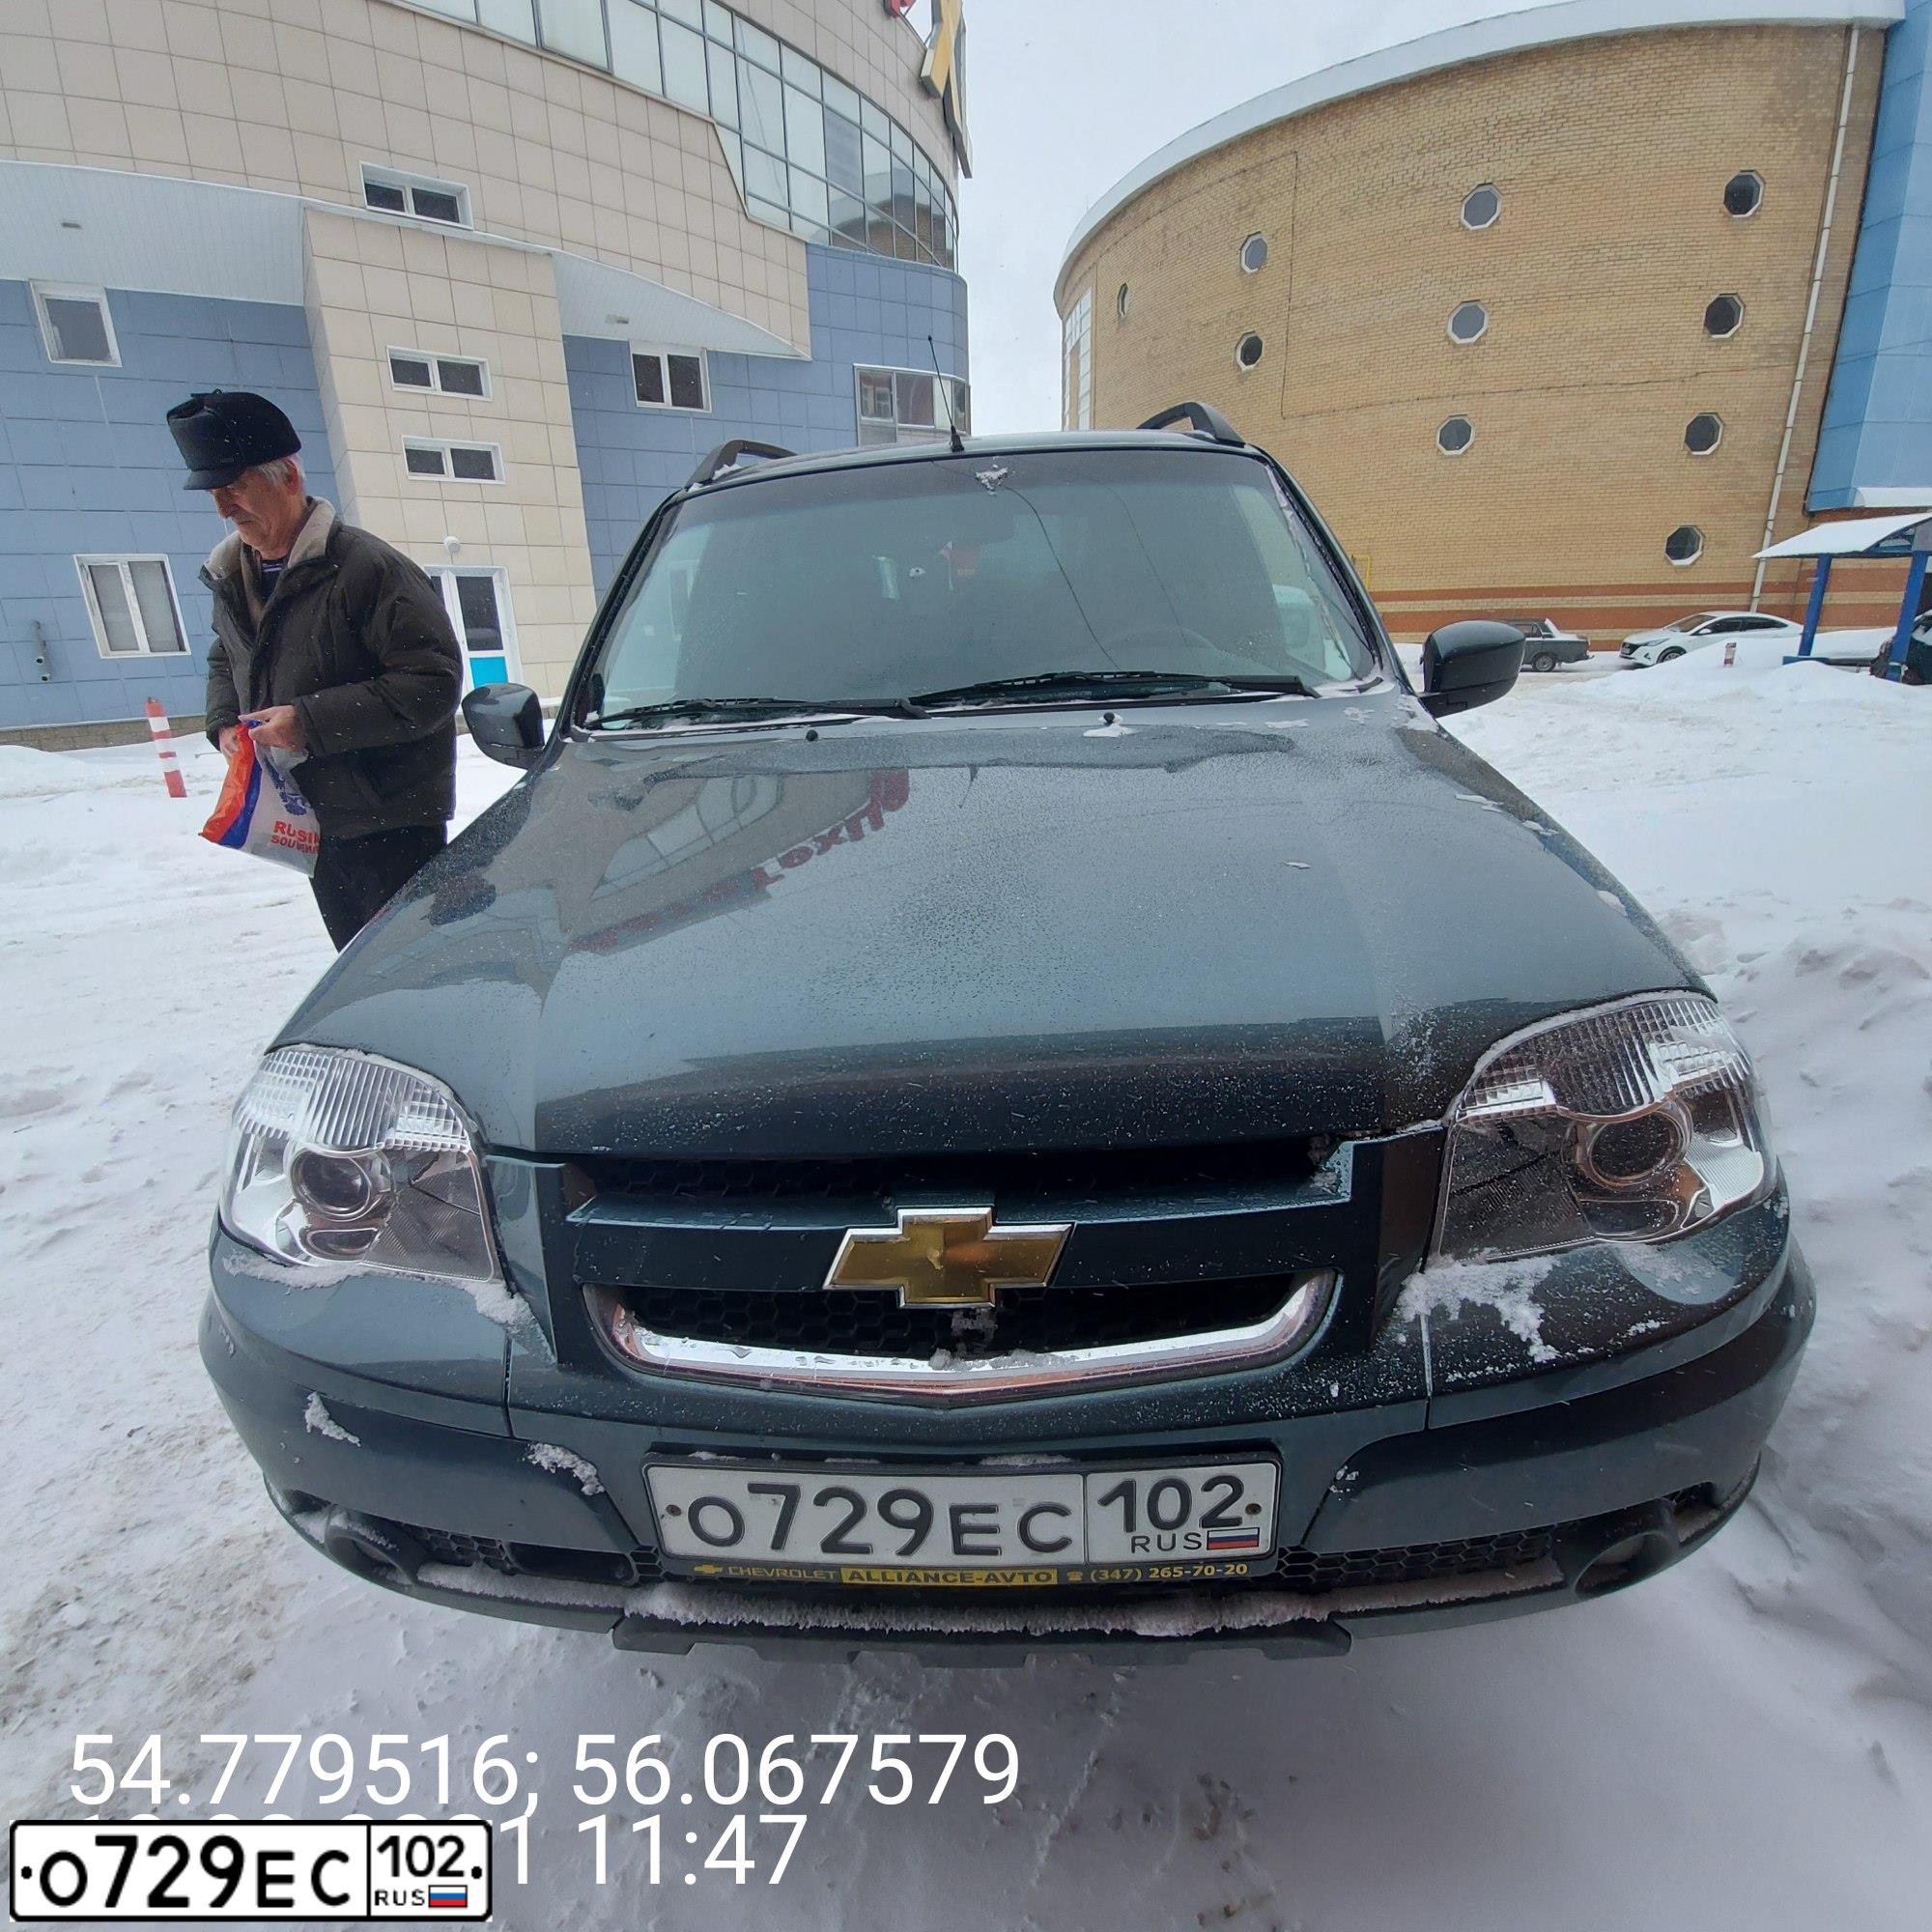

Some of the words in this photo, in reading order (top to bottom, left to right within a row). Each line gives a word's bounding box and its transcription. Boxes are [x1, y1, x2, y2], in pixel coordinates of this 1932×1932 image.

[687, 1482, 1073, 1555] О729ЕС
[1096, 1474, 1245, 1533] 102
[1130, 1532, 1203, 1553] RUS
[728, 1566, 836, 1580] CHEVROLET
[848, 1569, 1052, 1584] ALLIANCE-AVTO
[1090, 1568, 1142, 1582] (347)
[1149, 1563, 1248, 1579] 265-70-20
